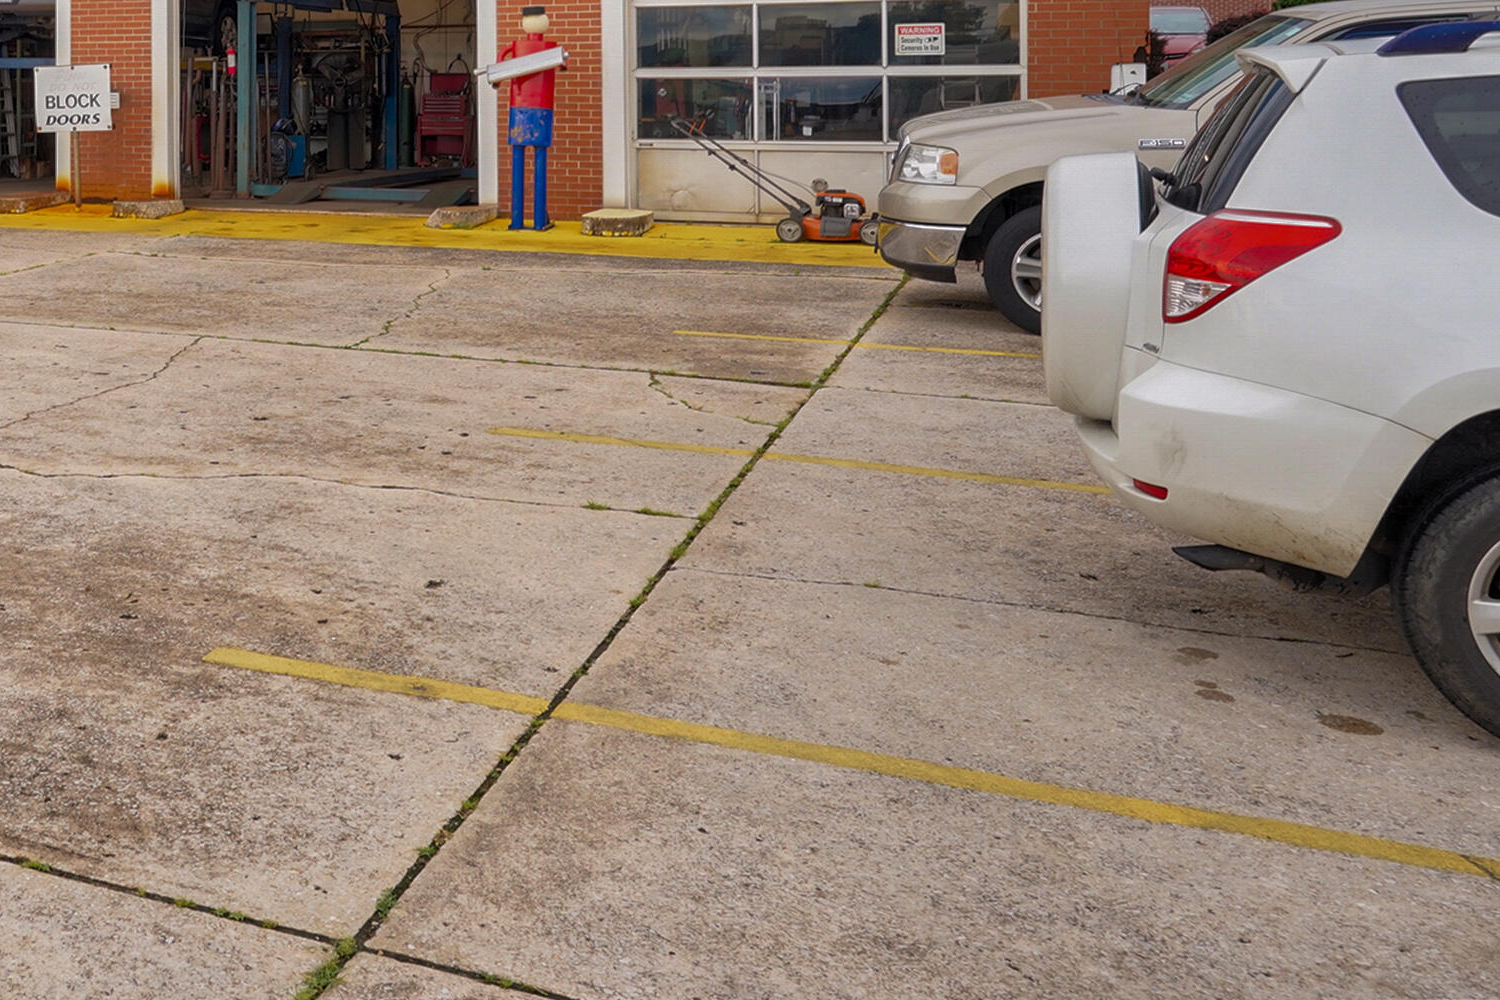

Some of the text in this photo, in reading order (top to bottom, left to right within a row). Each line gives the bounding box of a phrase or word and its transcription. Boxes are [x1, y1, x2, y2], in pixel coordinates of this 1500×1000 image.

[900, 26, 940, 34] WARNING
[901, 36, 923, 44] Security
[45, 93, 101, 110] BLOCK
[45, 112, 101, 126] DOORS
